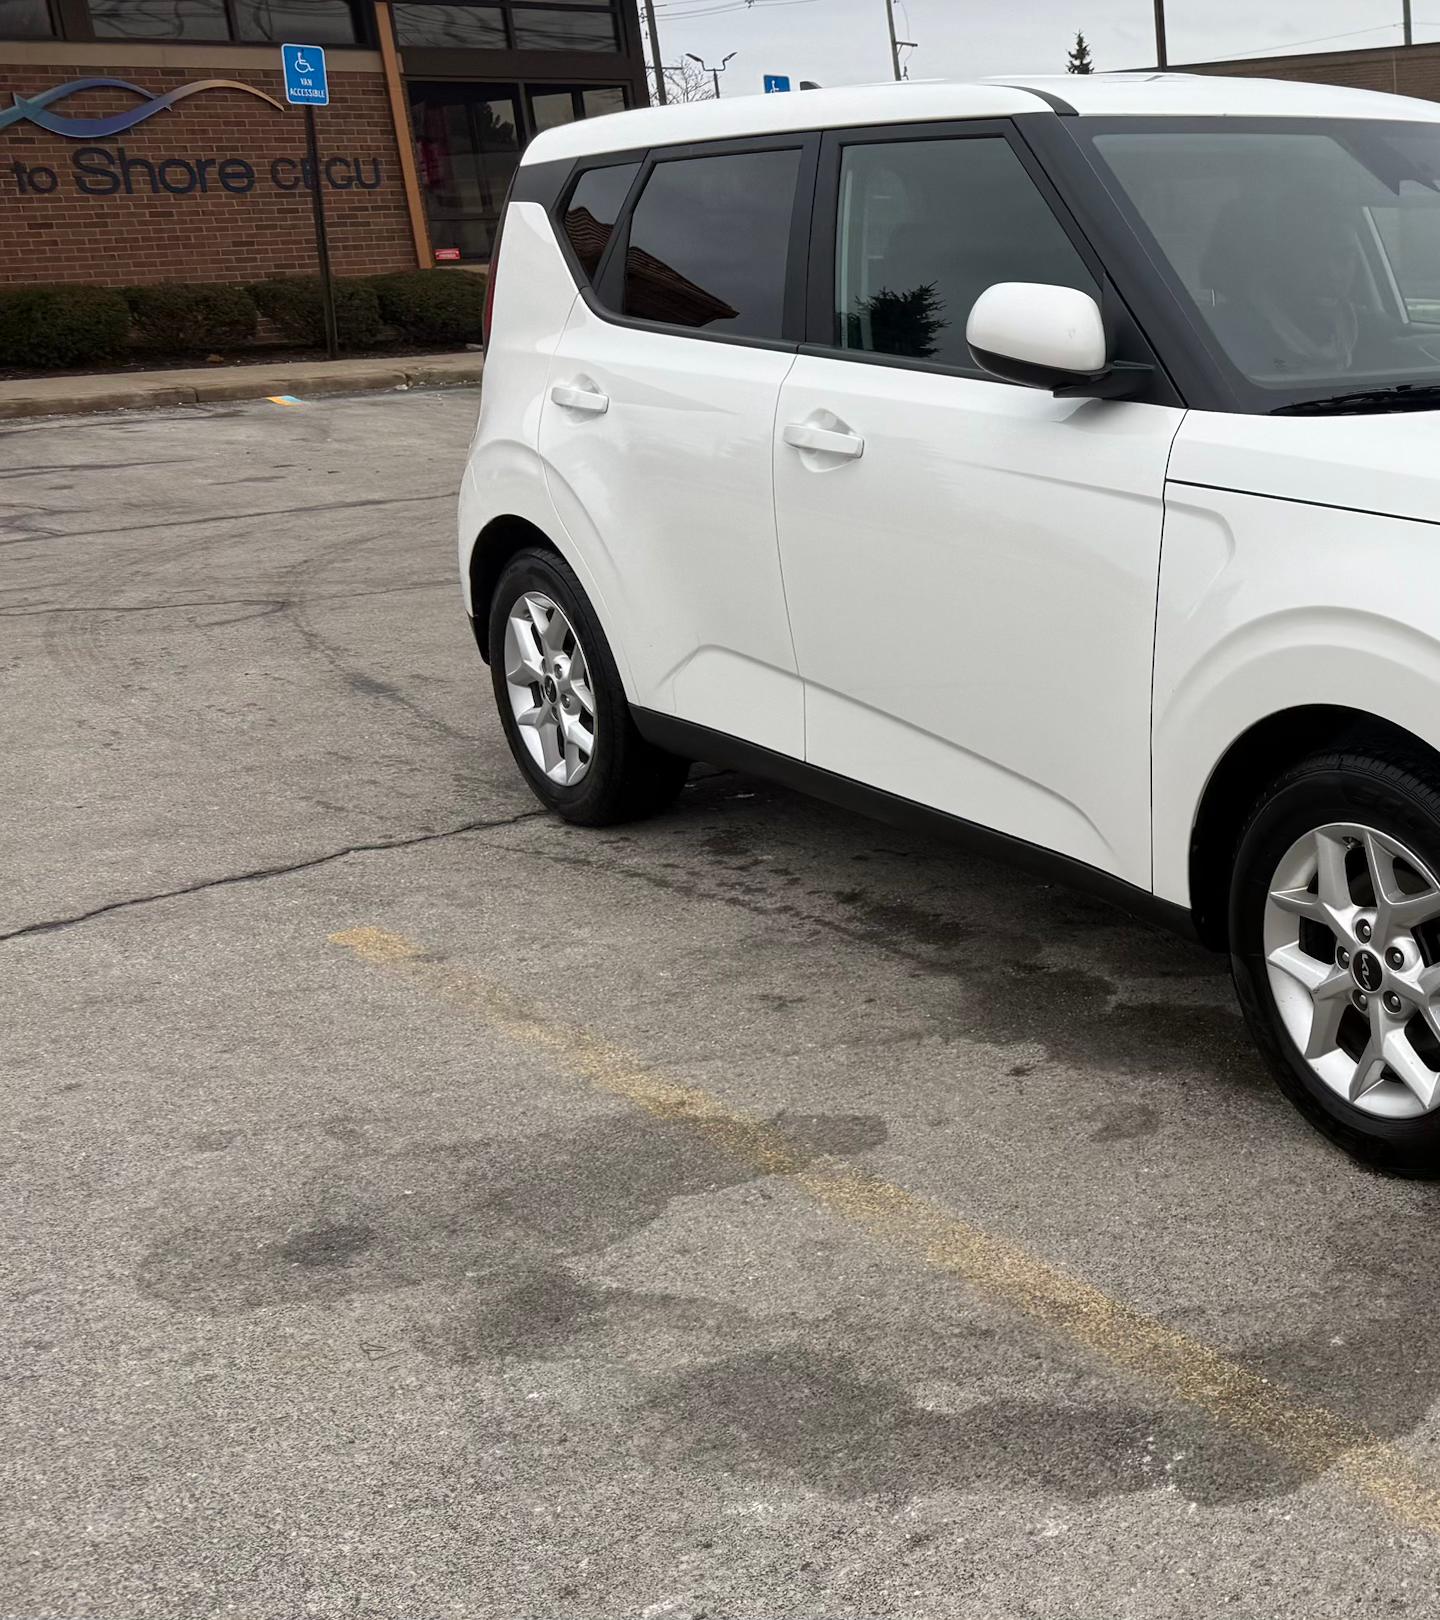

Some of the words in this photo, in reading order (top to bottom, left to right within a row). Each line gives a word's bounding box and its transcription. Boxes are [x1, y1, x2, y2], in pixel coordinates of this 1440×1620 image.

[300, 77, 313, 87] VAN
[289, 87, 325, 98] ACCESSIBLE
[11, 158, 58, 194] to
[72, 147, 255, 195] Shore
